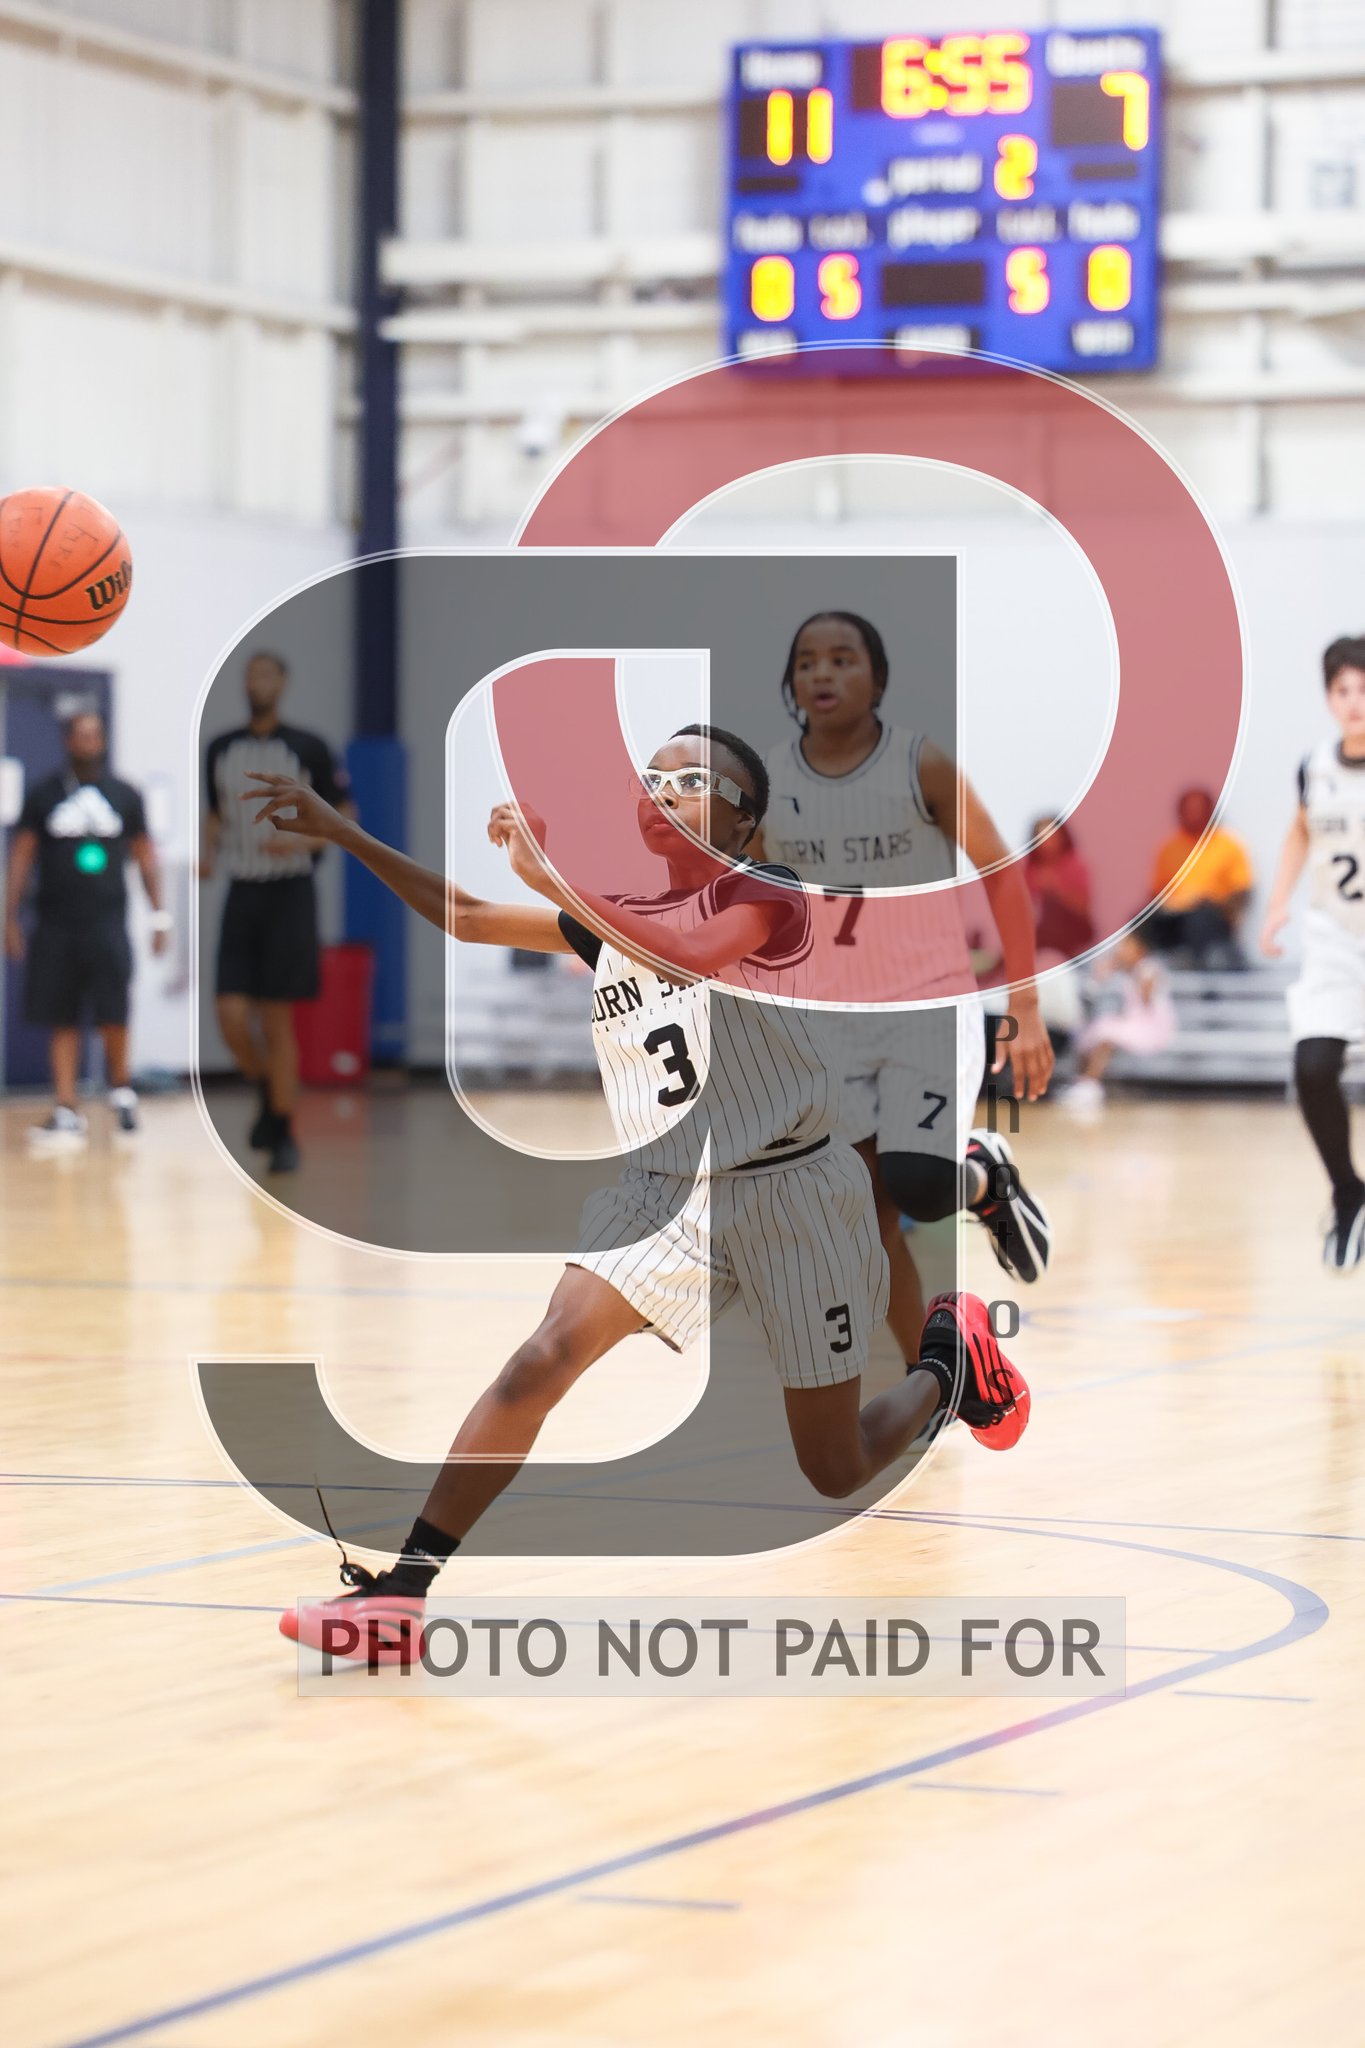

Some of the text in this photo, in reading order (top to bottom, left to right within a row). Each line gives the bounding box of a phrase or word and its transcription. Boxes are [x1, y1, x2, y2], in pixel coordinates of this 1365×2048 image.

[881, 33, 1033, 118] 6:55
[766, 88, 833, 165] 11
[1100, 71, 1150, 151] 7
[993, 134, 1038, 200] 2
[843, 827, 913, 863] STARS
[1332, 853, 1364, 901] 2
[822, 885, 864, 946] 7
[591, 976, 643, 1023] ORN
[643, 1022, 702, 1108] 3
[917, 1091, 947, 1130] 7
[825, 1302, 852, 1354] 3
